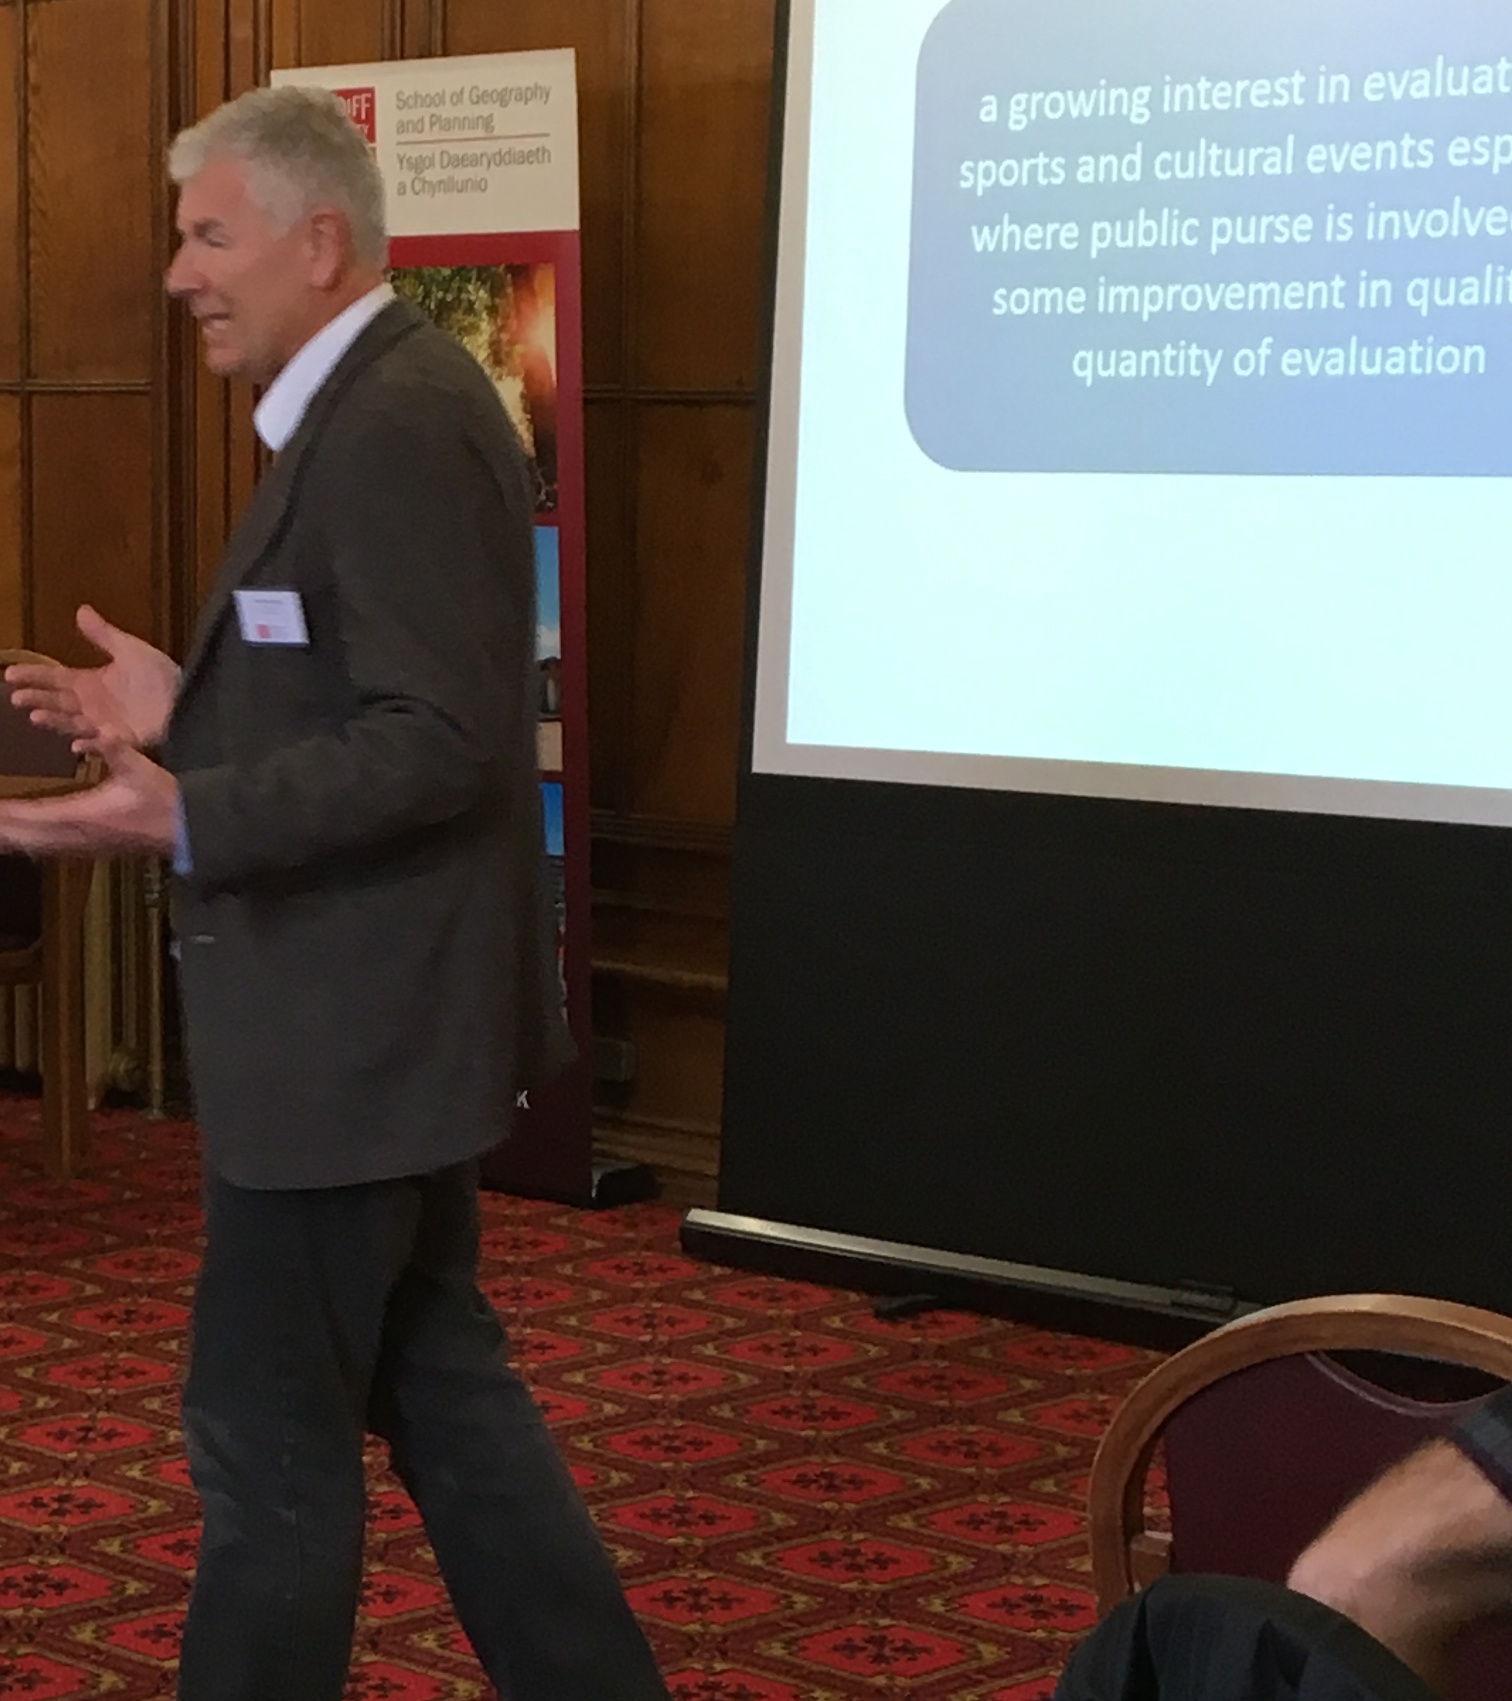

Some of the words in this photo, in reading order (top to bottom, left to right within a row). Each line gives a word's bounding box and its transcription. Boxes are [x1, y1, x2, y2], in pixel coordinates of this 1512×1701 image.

[395, 90, 445, 111] School
[449, 87, 464, 105] of
[468, 83, 552, 108] Geography
[979, 92, 998, 122] a
[1007, 78, 1152, 131] growing
[1163, 73, 1306, 112] interest
[1317, 65, 1350, 103] in
[1363, 55, 1512, 101] evaluat
[395, 117, 424, 134] and
[429, 111, 495, 133] Planning
[396, 152, 436, 174] Ysgol
[440, 145, 552, 171] Daearyddiaeth
[959, 151, 1066, 197] sports
[1076, 142, 1143, 184] and
[1153, 134, 1294, 180] cultural
[1306, 132, 1434, 175] events
[1447, 133, 1512, 175] esp
[397, 182, 407, 196] a
[971, 212, 1080, 253] where
[1090, 208, 1200, 258] public
[1211, 212, 1314, 255] purse
[1325, 204, 1354, 242] is
[1366, 195, 1512, 242] involve
[992, 283, 1087, 316] some
[1097, 273, 1346, 322] improvement
[1358, 270, 1392, 309] in
[1072, 339, 1224, 388] quantity
[1232, 336, 1275, 378] of
[1280, 335, 1487, 379] evaluation
